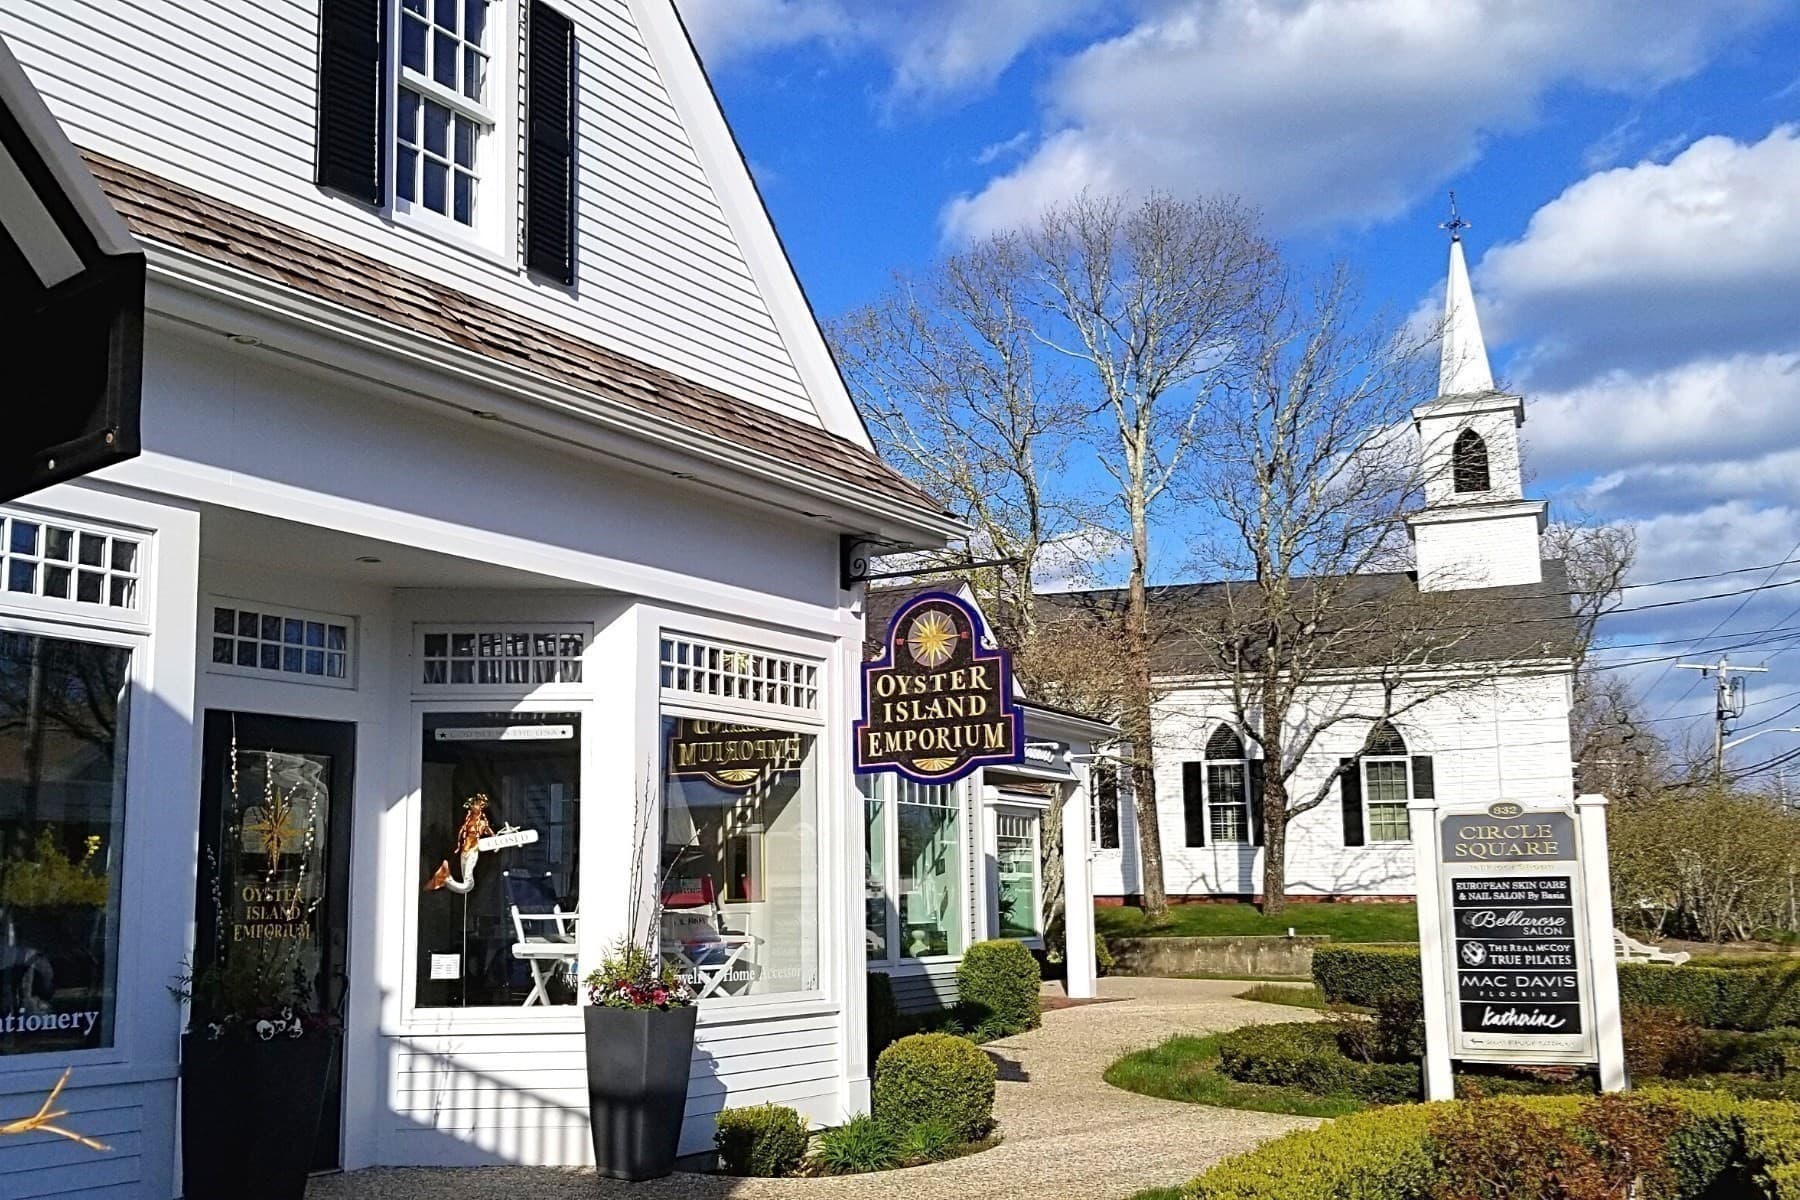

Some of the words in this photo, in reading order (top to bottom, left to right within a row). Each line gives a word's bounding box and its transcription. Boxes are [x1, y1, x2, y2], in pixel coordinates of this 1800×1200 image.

[876, 666, 992, 697] OYSTER
[883, 695, 987, 723] ISLAND
[868, 722, 1005, 757] EMPORIUM
[1493, 805, 1518, 814] 832
[1459, 824, 1553, 840] CIRCLE
[1455, 841, 1559, 860] SQUARE
[1456, 882, 1511, 890] EUROPEAN
[1512, 881, 1537, 890] SKIN
[1539, 881, 1567, 889] CARE
[242, 886, 305, 904] OYSTER
[1458, 892, 1466, 900] &
[1468, 892, 1492, 900] NAIL
[1493, 892, 1526, 900] SALON
[1527, 891, 1540, 901] By
[246, 905, 302, 921] ISLAND
[1472, 910, 1567, 928] Bellarose
[233, 923, 311, 942] EMPORIUM
[1522, 927, 1563, 936] SALON
[1510, 943, 1534, 952] REAL
[1489, 955, 1522, 965] TRUE
[1525, 955, 1572, 965] PILATES
[723, 966, 756, 982] Home
[1461, 975, 1508, 987] MAC
[1515, 975, 1576, 987] DAVIS
